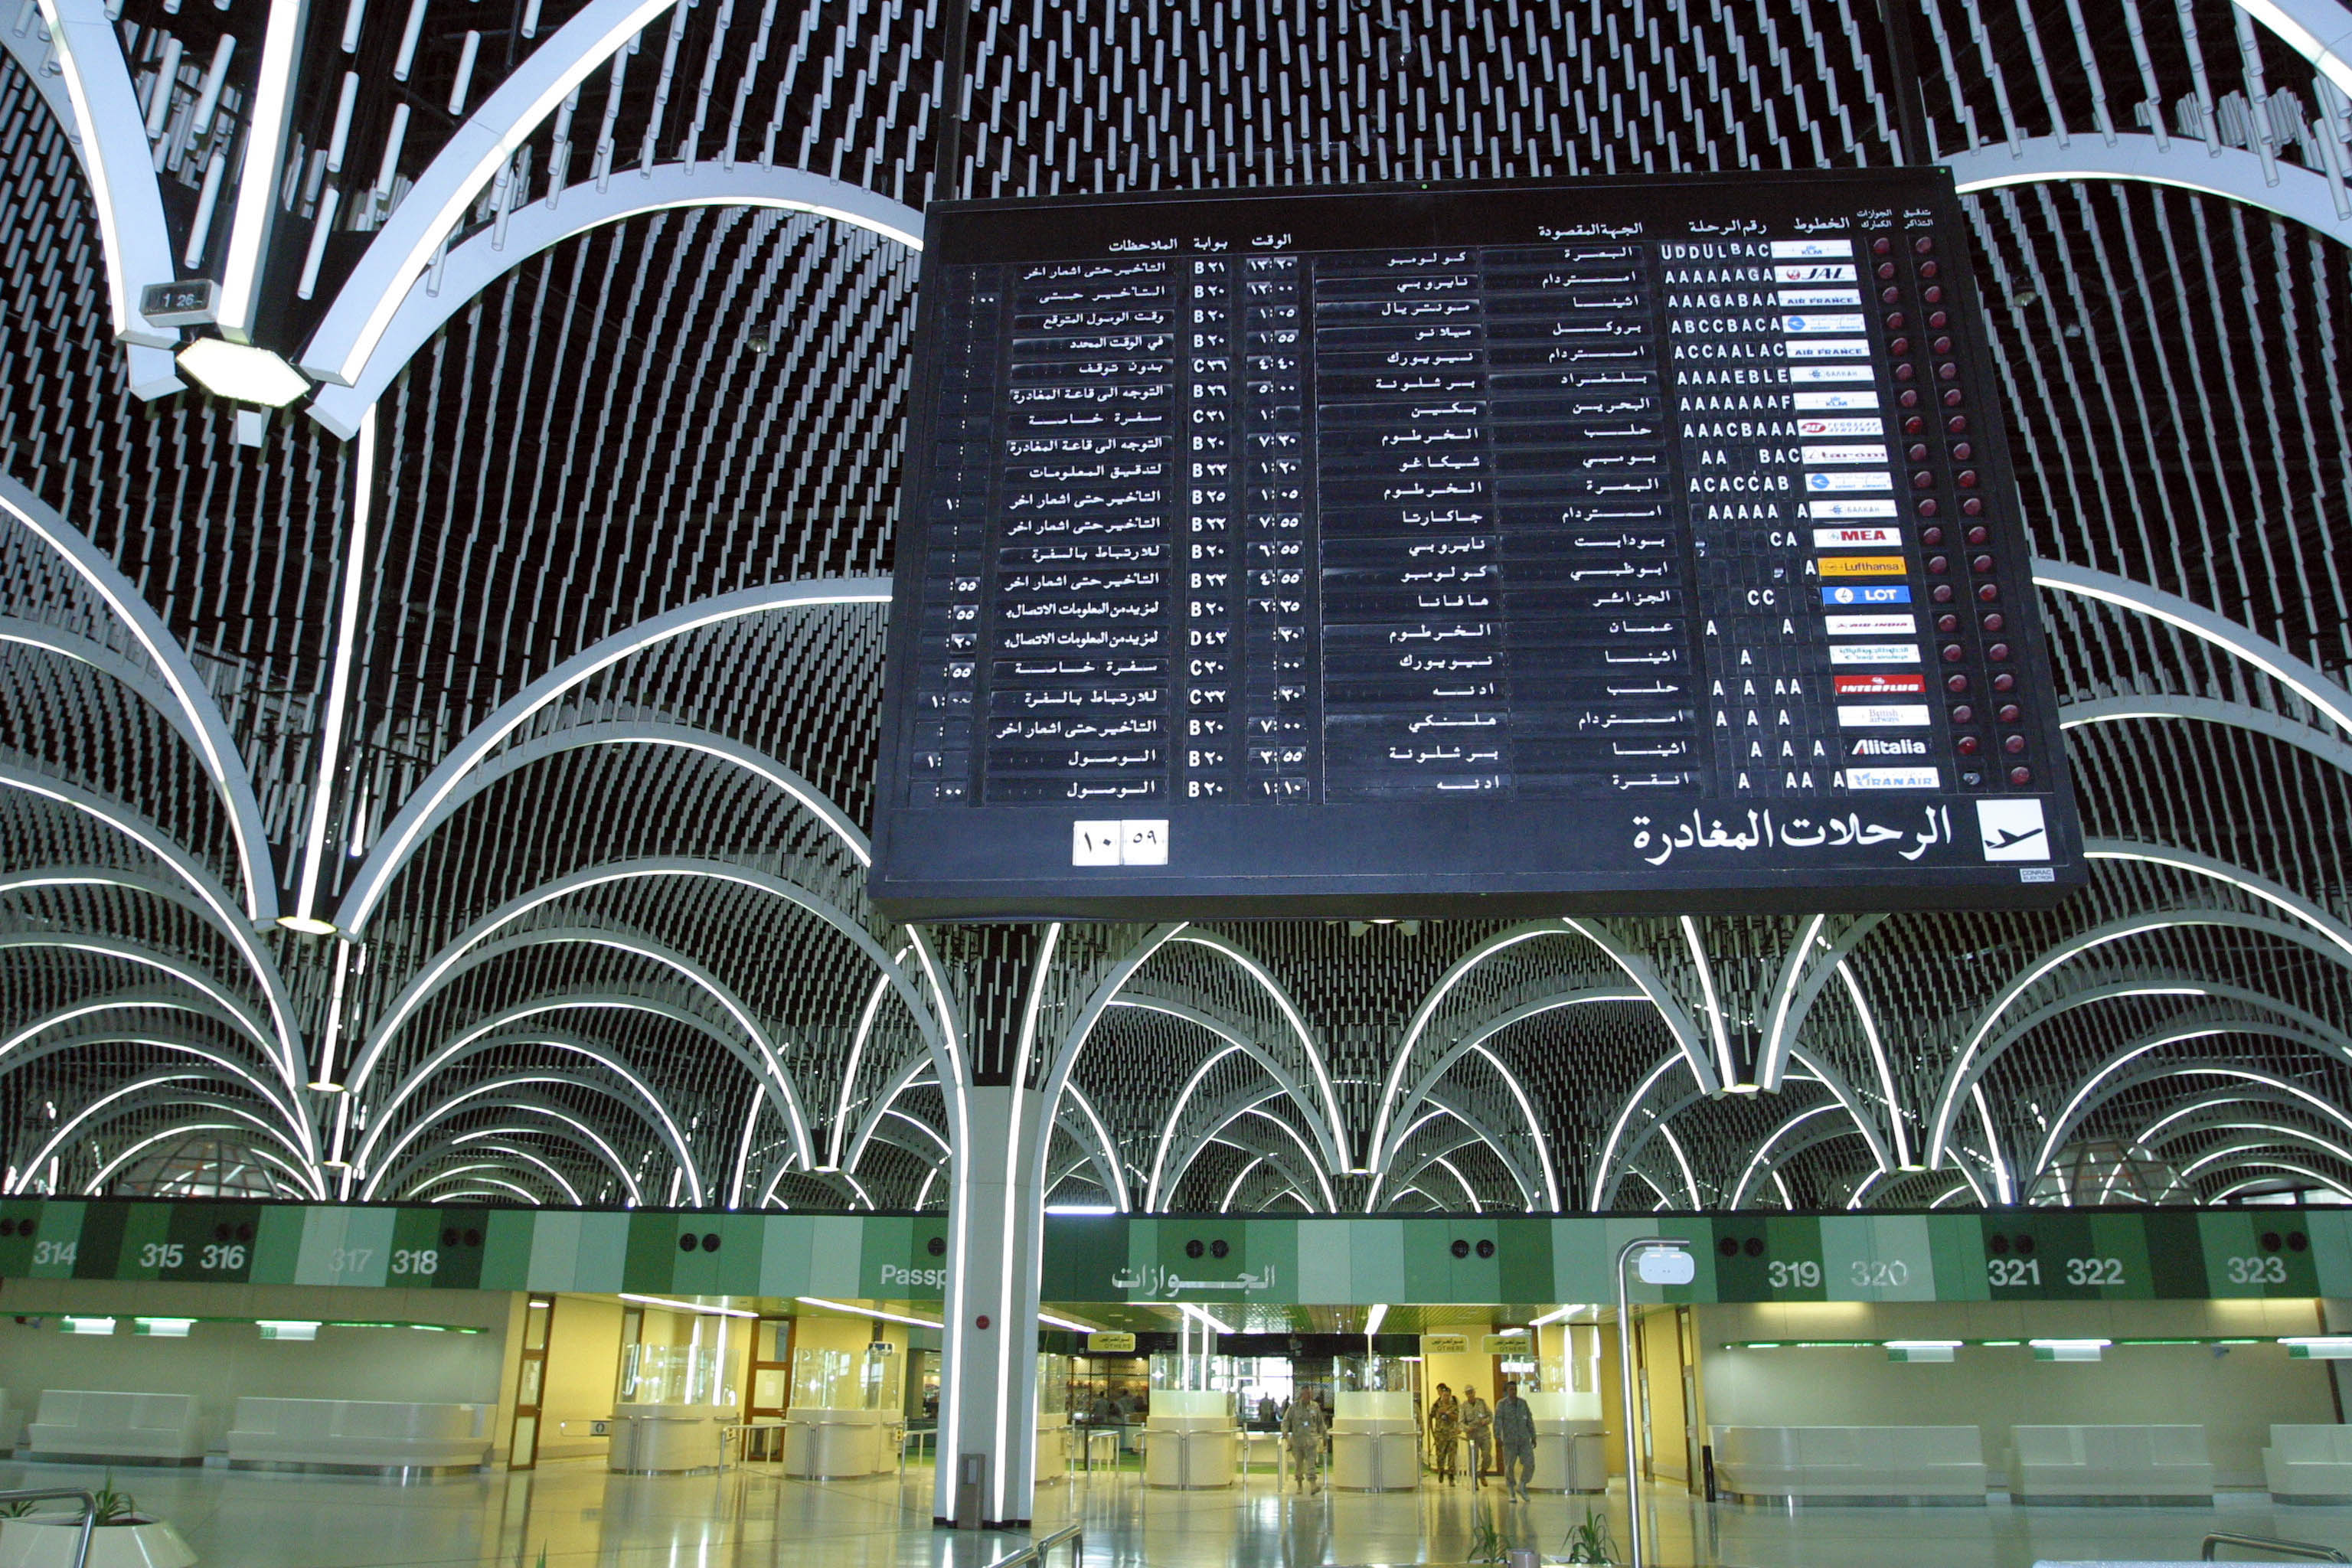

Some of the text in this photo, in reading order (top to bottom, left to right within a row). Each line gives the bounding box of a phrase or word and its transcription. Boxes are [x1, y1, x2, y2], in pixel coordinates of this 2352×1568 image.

[1743, 220, 1767, 237] رقم
[1794, 217, 1850, 234] الخطوط
[1194, 237, 1228, 252] بوابة
[1252, 234, 1292, 250] الوقت
[1194, 261, 1204, 274] B
[1802, 268, 1845, 279] JAL
[1194, 359, 1204, 373] C
[1193, 410, 1204, 423] C
[1192, 490, 1203, 505] B
[1841, 531, 1886, 541] MEA
[1844, 563, 1899, 571] Lufthansa
[1864, 590, 1897, 600] LOT
[1191, 631, 1201, 646] D
[1190, 659, 1202, 676] C
[1851, 739, 1926, 755] Alitalia
[1188, 781, 1200, 797] B
[1632, 805, 1952, 866] الرحلات المغادرة
[33, 1240, 77, 1265] 314
[139, 1243, 185, 1269] 315
[201, 1245, 246, 1269] 316
[391, 1250, 439, 1275] 318
[2228, 1256, 2286, 1284] 323
[880, 1264, 946, 1290] Passp
[1768, 1261, 1821, 1289] 319
[1988, 1259, 2040, 1286] 321
[2066, 1258, 2125, 1285] 322
[1111, 1264, 1276, 1298] الجوازات
